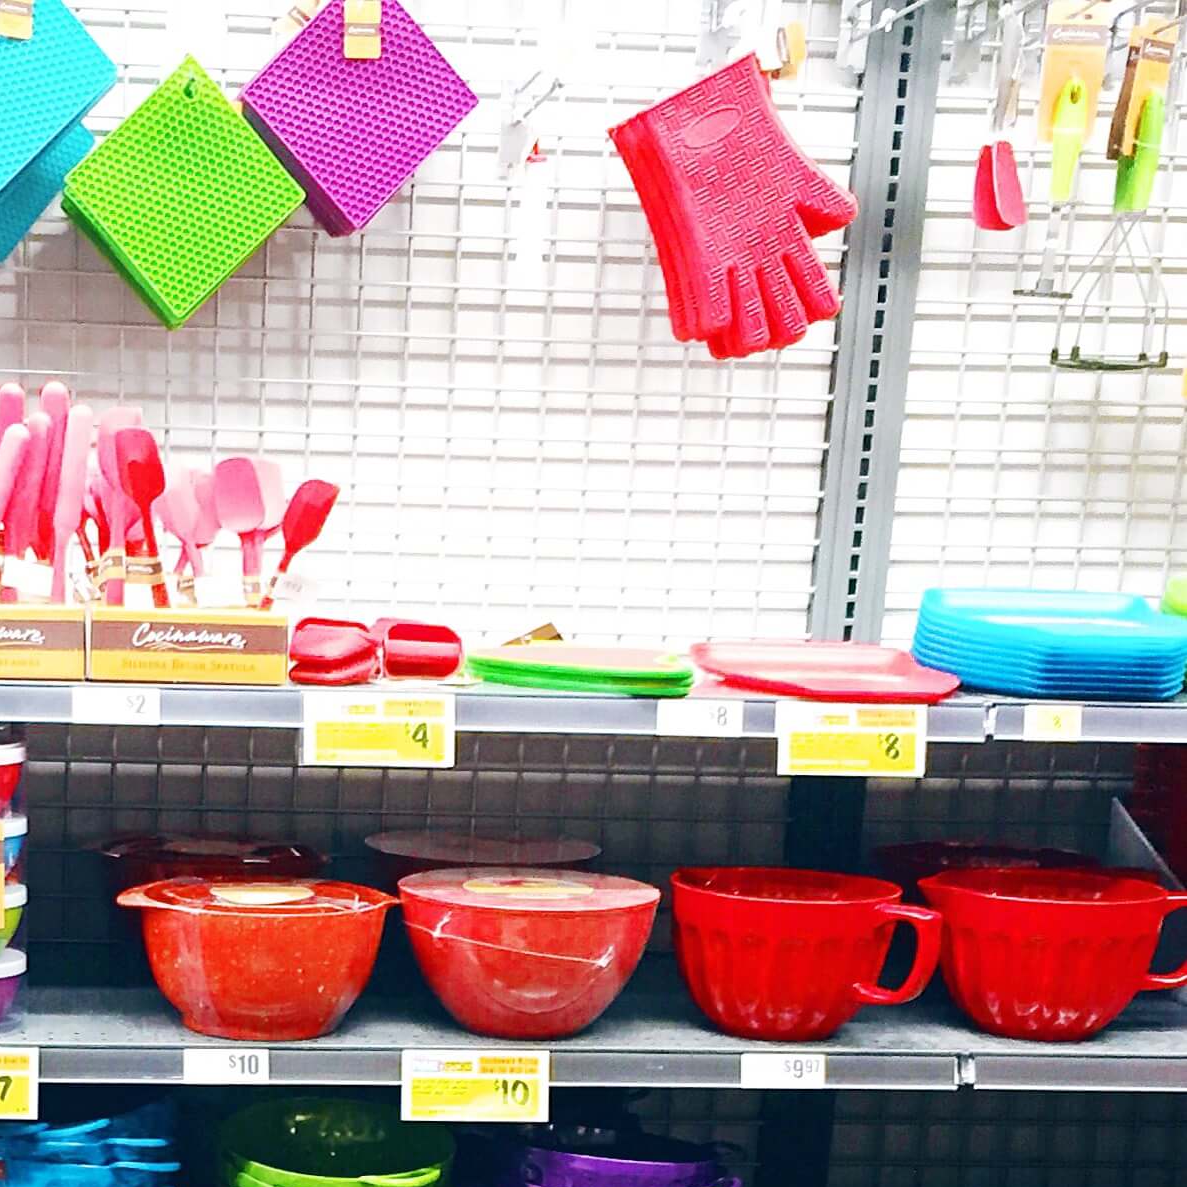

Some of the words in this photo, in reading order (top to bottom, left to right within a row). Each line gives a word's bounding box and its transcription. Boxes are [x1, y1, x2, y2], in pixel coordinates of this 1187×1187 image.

[132, 623, 247, 649] Cocinaware
[126, 695, 147, 714] $2
[228, 1055, 259, 1075] $10
[493, 1079, 530, 1106] $10
